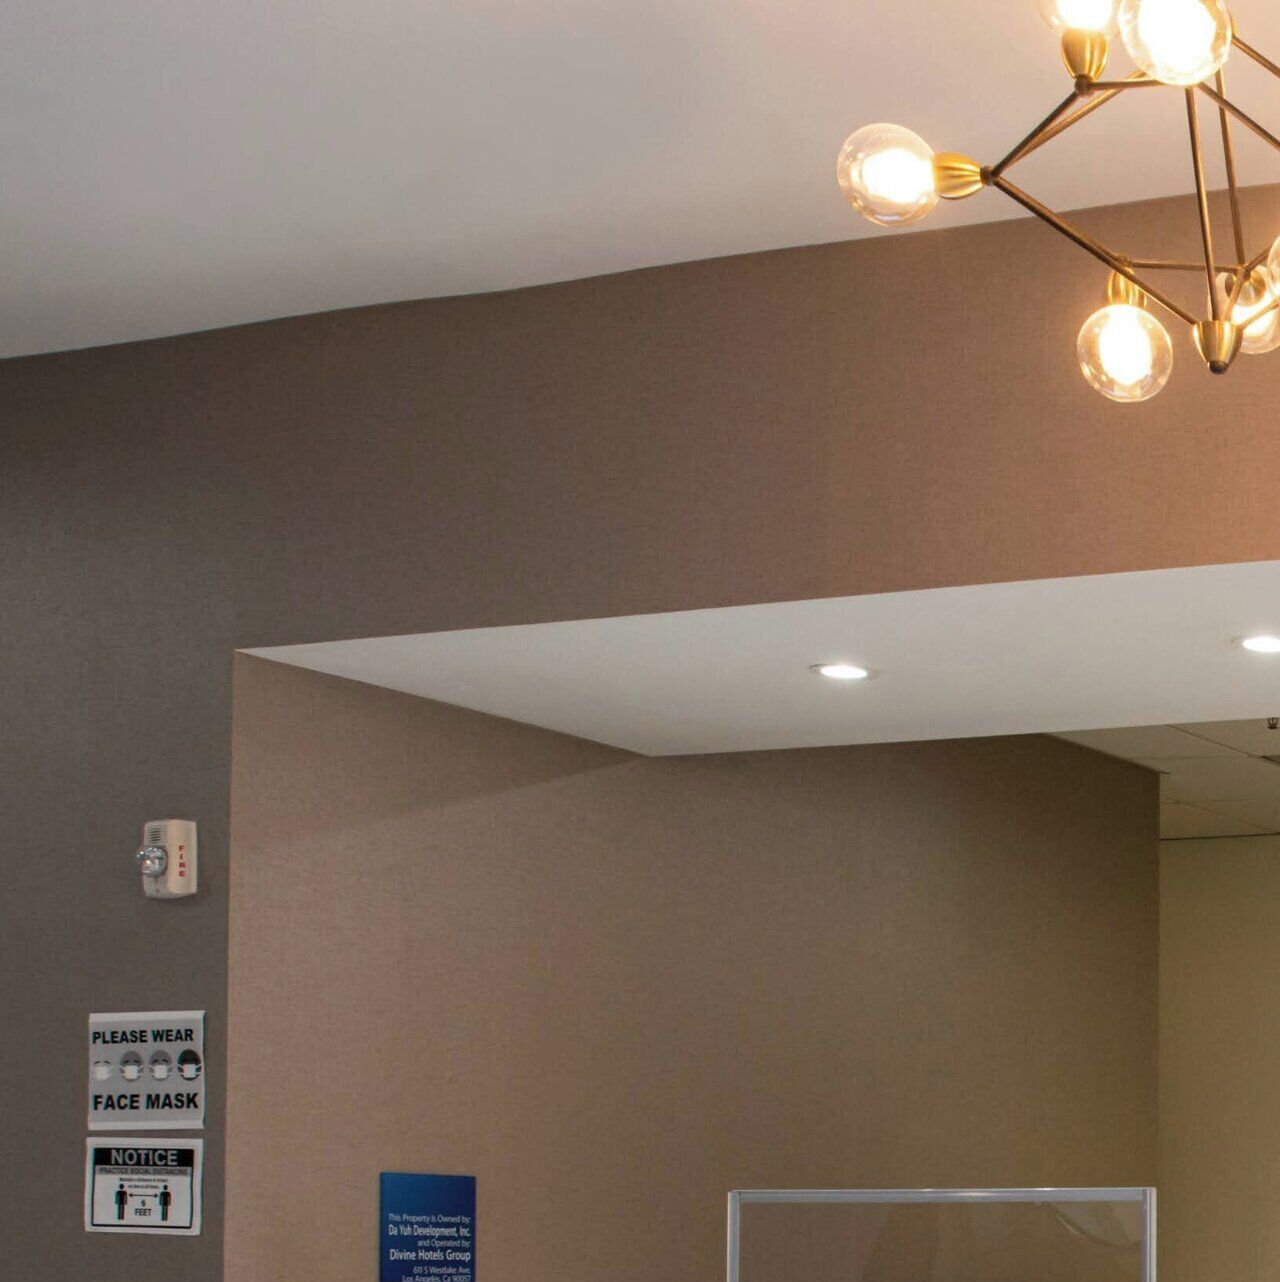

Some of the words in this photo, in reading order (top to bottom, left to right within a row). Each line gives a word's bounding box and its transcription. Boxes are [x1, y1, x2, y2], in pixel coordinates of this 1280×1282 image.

[178, 845, 187, 877] FIRE
[92, 1030, 148, 1044] PLEASE
[151, 1028, 194, 1042] WEAR
[93, 1094, 140, 1110] FACE
[145, 1092, 199, 1109] MASK
[111, 1149, 178, 1166] NOTICE
[99, 1167, 129, 1175] PRACTICE
[130, 1167, 151, 1175] SOCIAL
[152, 1168, 188, 1176] DISTANCING
[134, 1208, 152, 1216] FEET
[389, 1213, 401, 1222] This
[402, 1213, 430, 1224] Property
[437, 1214, 461, 1223] Owned
[389, 1225, 398, 1235] Da
[400, 1225, 411, 1236] Yuh
[413, 1225, 459, 1238] Development,
[459, 1226, 471, 1237] Inc.
[417, 1239, 430, 1247] and
[430, 1239, 461, 1248] Operated
[389, 1249, 416, 1260] Divine
[418, 1249, 444, 1260] Hotels
[446, 1250, 471, 1262] Group
[424, 1266, 429, 1274] S
[429, 1266, 457, 1274] Westlake
[402, 1275, 414, 1282] Los
